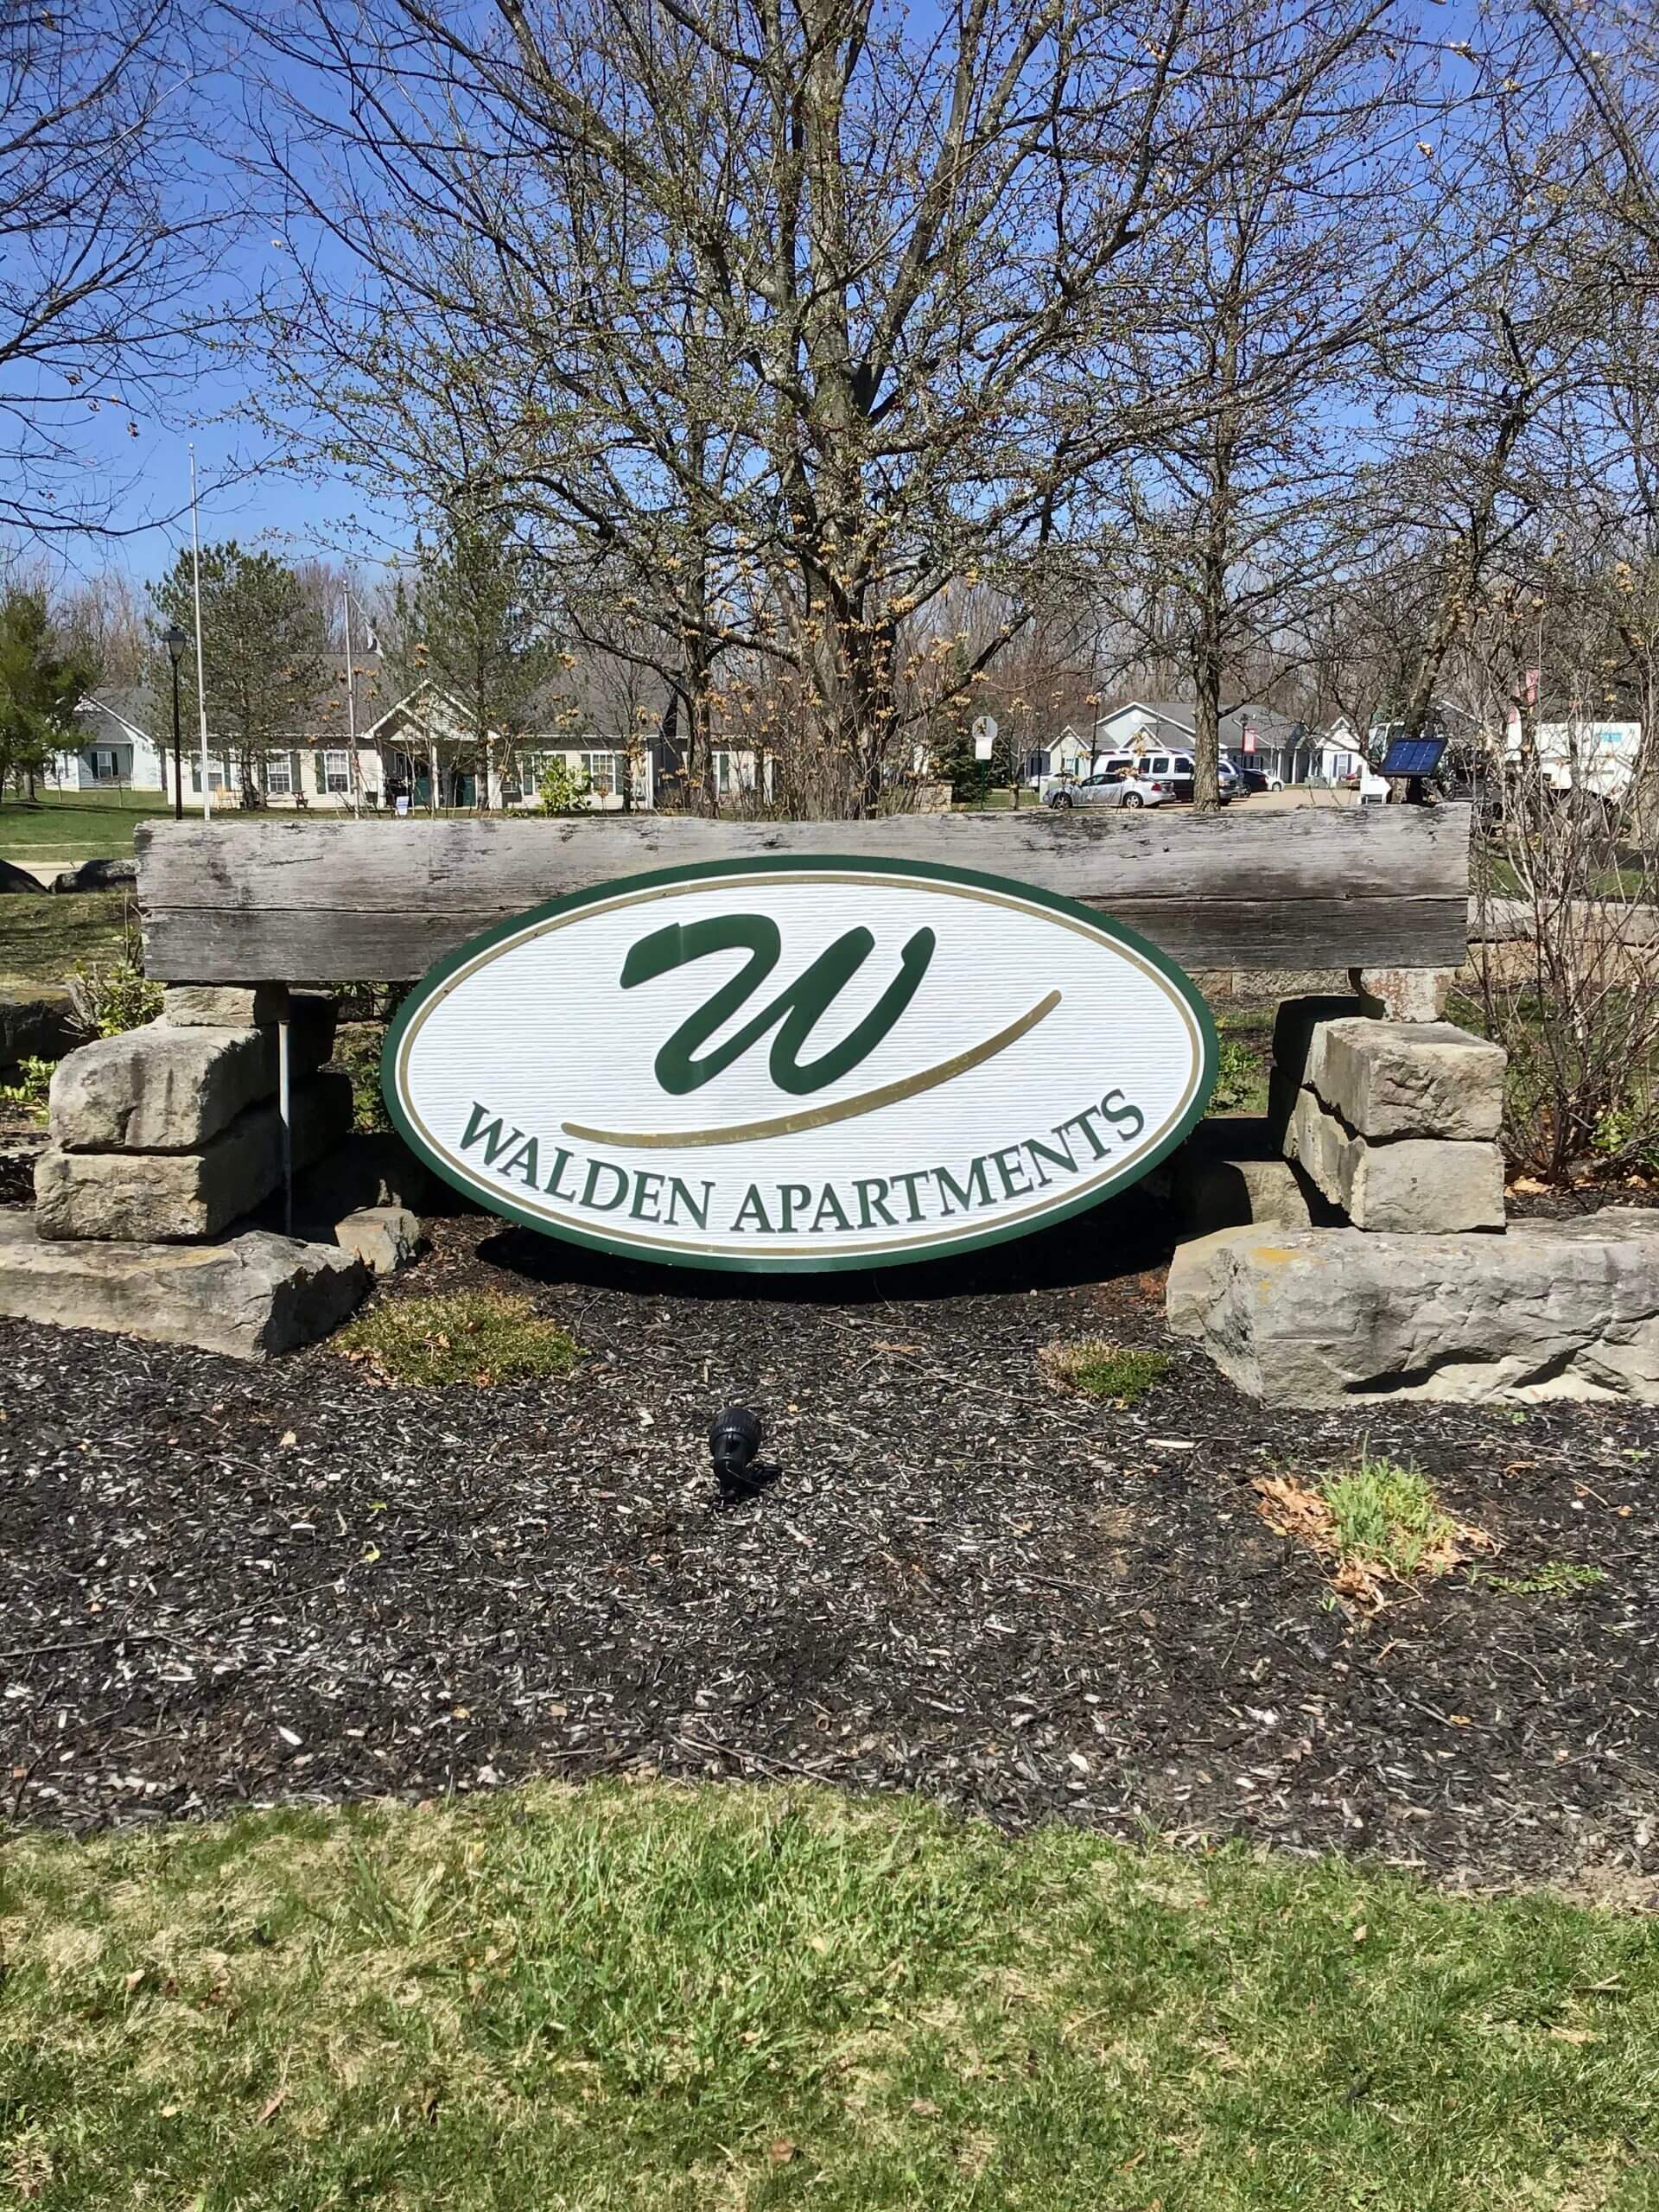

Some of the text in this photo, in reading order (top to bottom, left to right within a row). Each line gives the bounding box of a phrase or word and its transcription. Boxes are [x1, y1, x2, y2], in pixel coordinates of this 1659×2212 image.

[620, 913, 936, 1096] W
[460, 1089, 1144, 1234] WALDEN APARTMENTS
